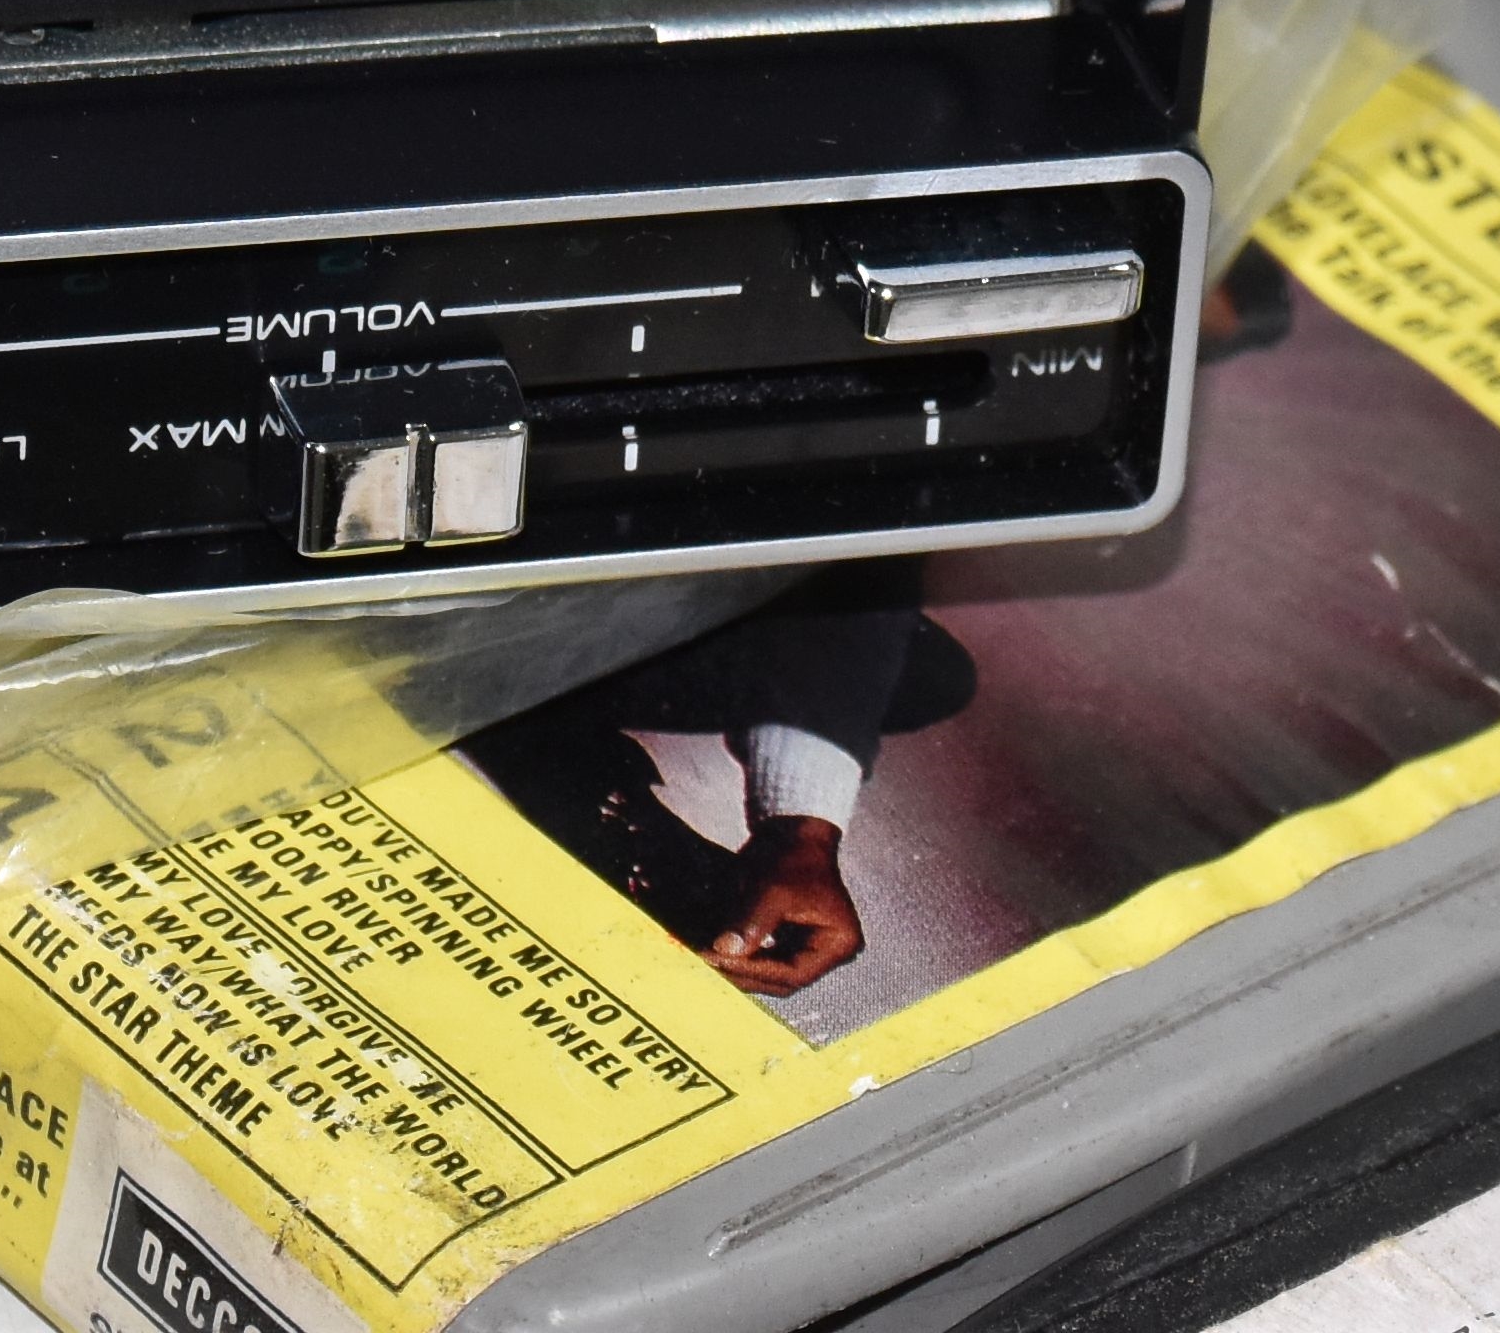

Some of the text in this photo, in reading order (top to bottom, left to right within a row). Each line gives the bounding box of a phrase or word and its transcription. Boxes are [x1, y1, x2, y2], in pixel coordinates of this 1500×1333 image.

[226, 301, 435, 342] VOLUME
[1263, 190, 1310, 236] he
[1320, 244, 1394, 310] Talk
[1398, 316, 1450, 341] of
[1011, 347, 1103, 377] MIN
[128, 417, 250, 453] MAX
[115, 690, 230, 770] 2
[131, 851, 195, 885] MY
[181, 885, 273, 959] LOVE
[223, 805, 423, 964] MOON RIVER
[226, 861, 292, 901] MY
[282, 906, 374, 973] LOVE
[261, 790, 632, 1089] HAPPY/SPINNING WHEEL
[9, 904, 272, 1136] THE STAR THEME
[414, 866, 517, 943] MADE
[511, 943, 573, 988] ME
[566, 989, 620, 1025] SO
[620, 1027, 714, 1093] VERY
[85, 861, 506, 1214] MY WAY/WHAT THE WORLD
[157, 963, 239, 1035] NOW
[228, 1034, 276, 1066] IS
[267, 1065, 363, 1141] LOVE
[16, 1151, 50, 1197] at
[137, 1228, 262, 1333] DECC
